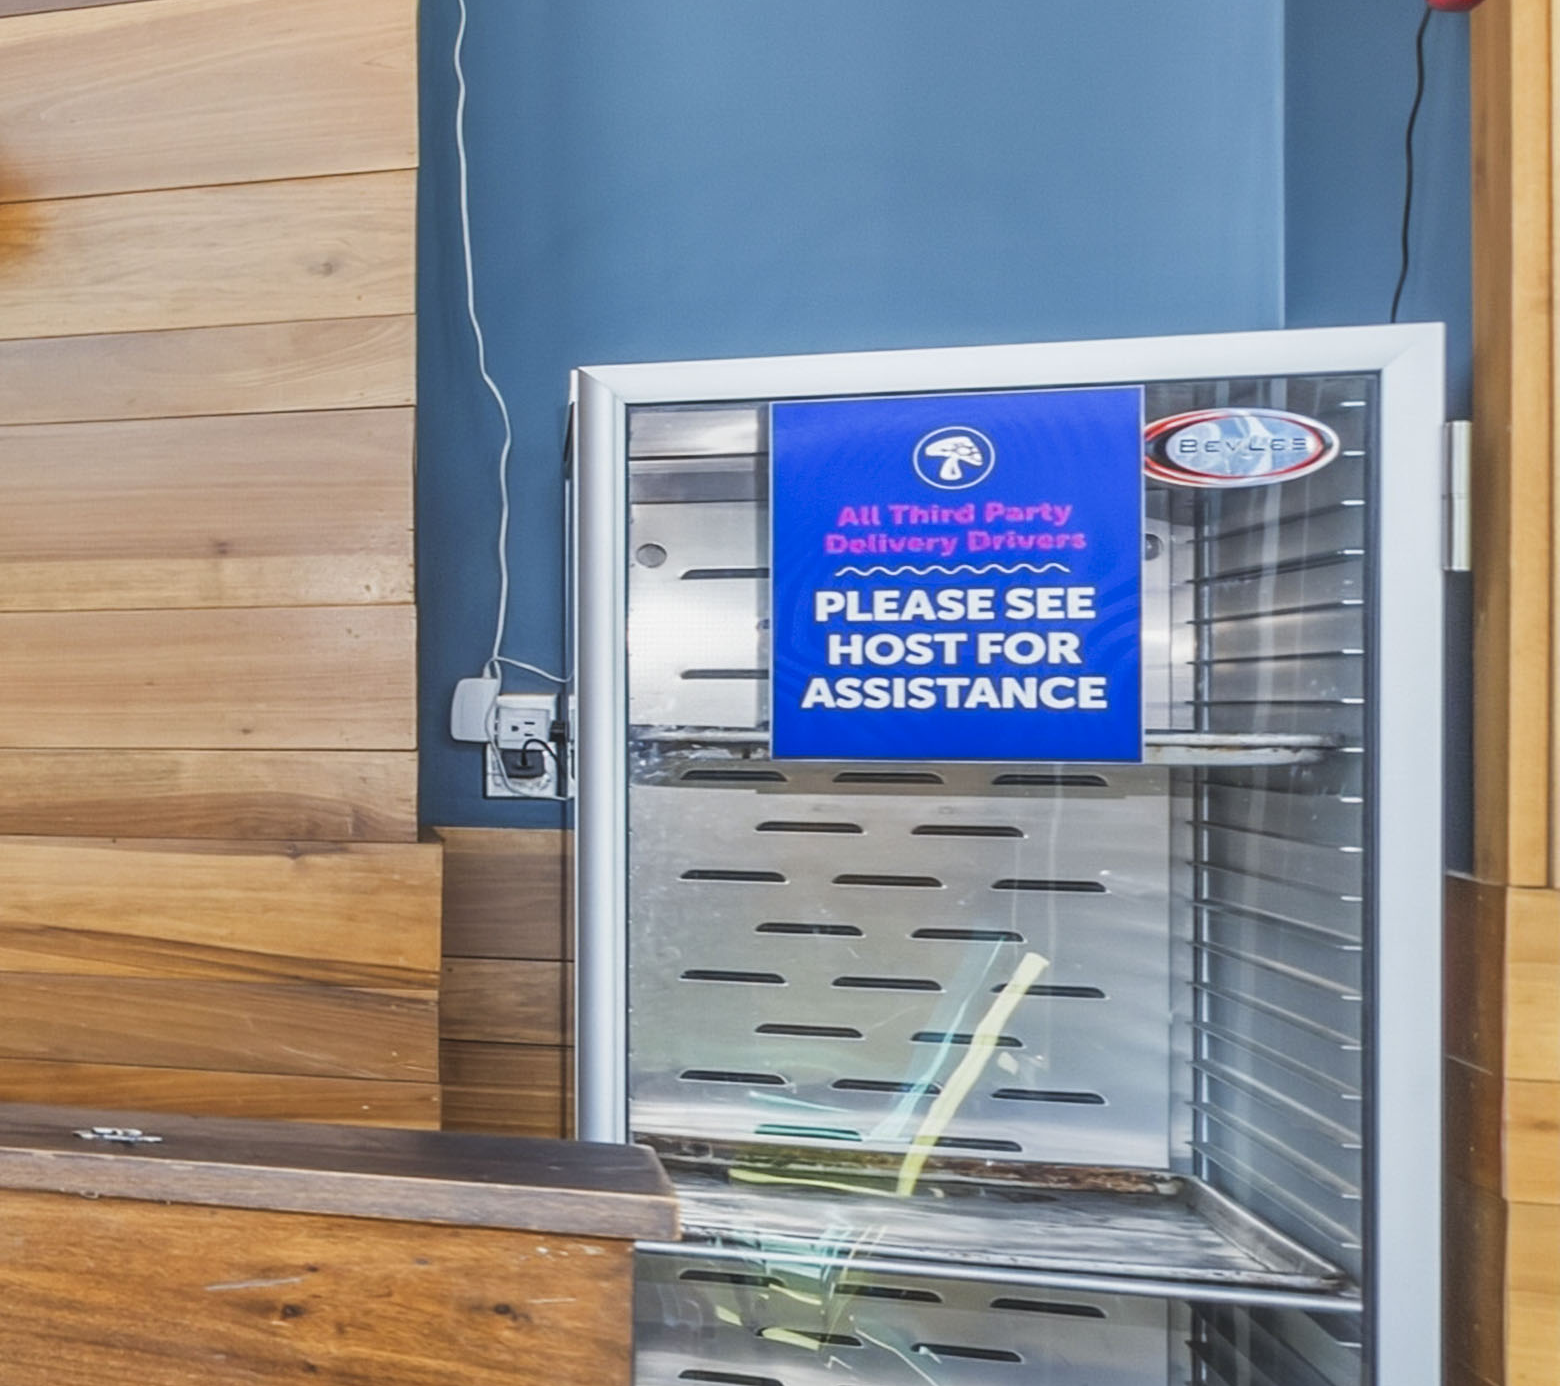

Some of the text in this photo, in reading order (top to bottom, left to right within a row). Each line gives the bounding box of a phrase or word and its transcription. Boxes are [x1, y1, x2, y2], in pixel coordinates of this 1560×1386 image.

[837, 501, 1073, 526] All Third Party
[824, 529, 1087, 556] Delivery Drivers
[814, 587, 1097, 622] PLEASE SEE
[828, 631, 1083, 666] HOST FOR
[800, 676, 1108, 710] ASSISTANCE
